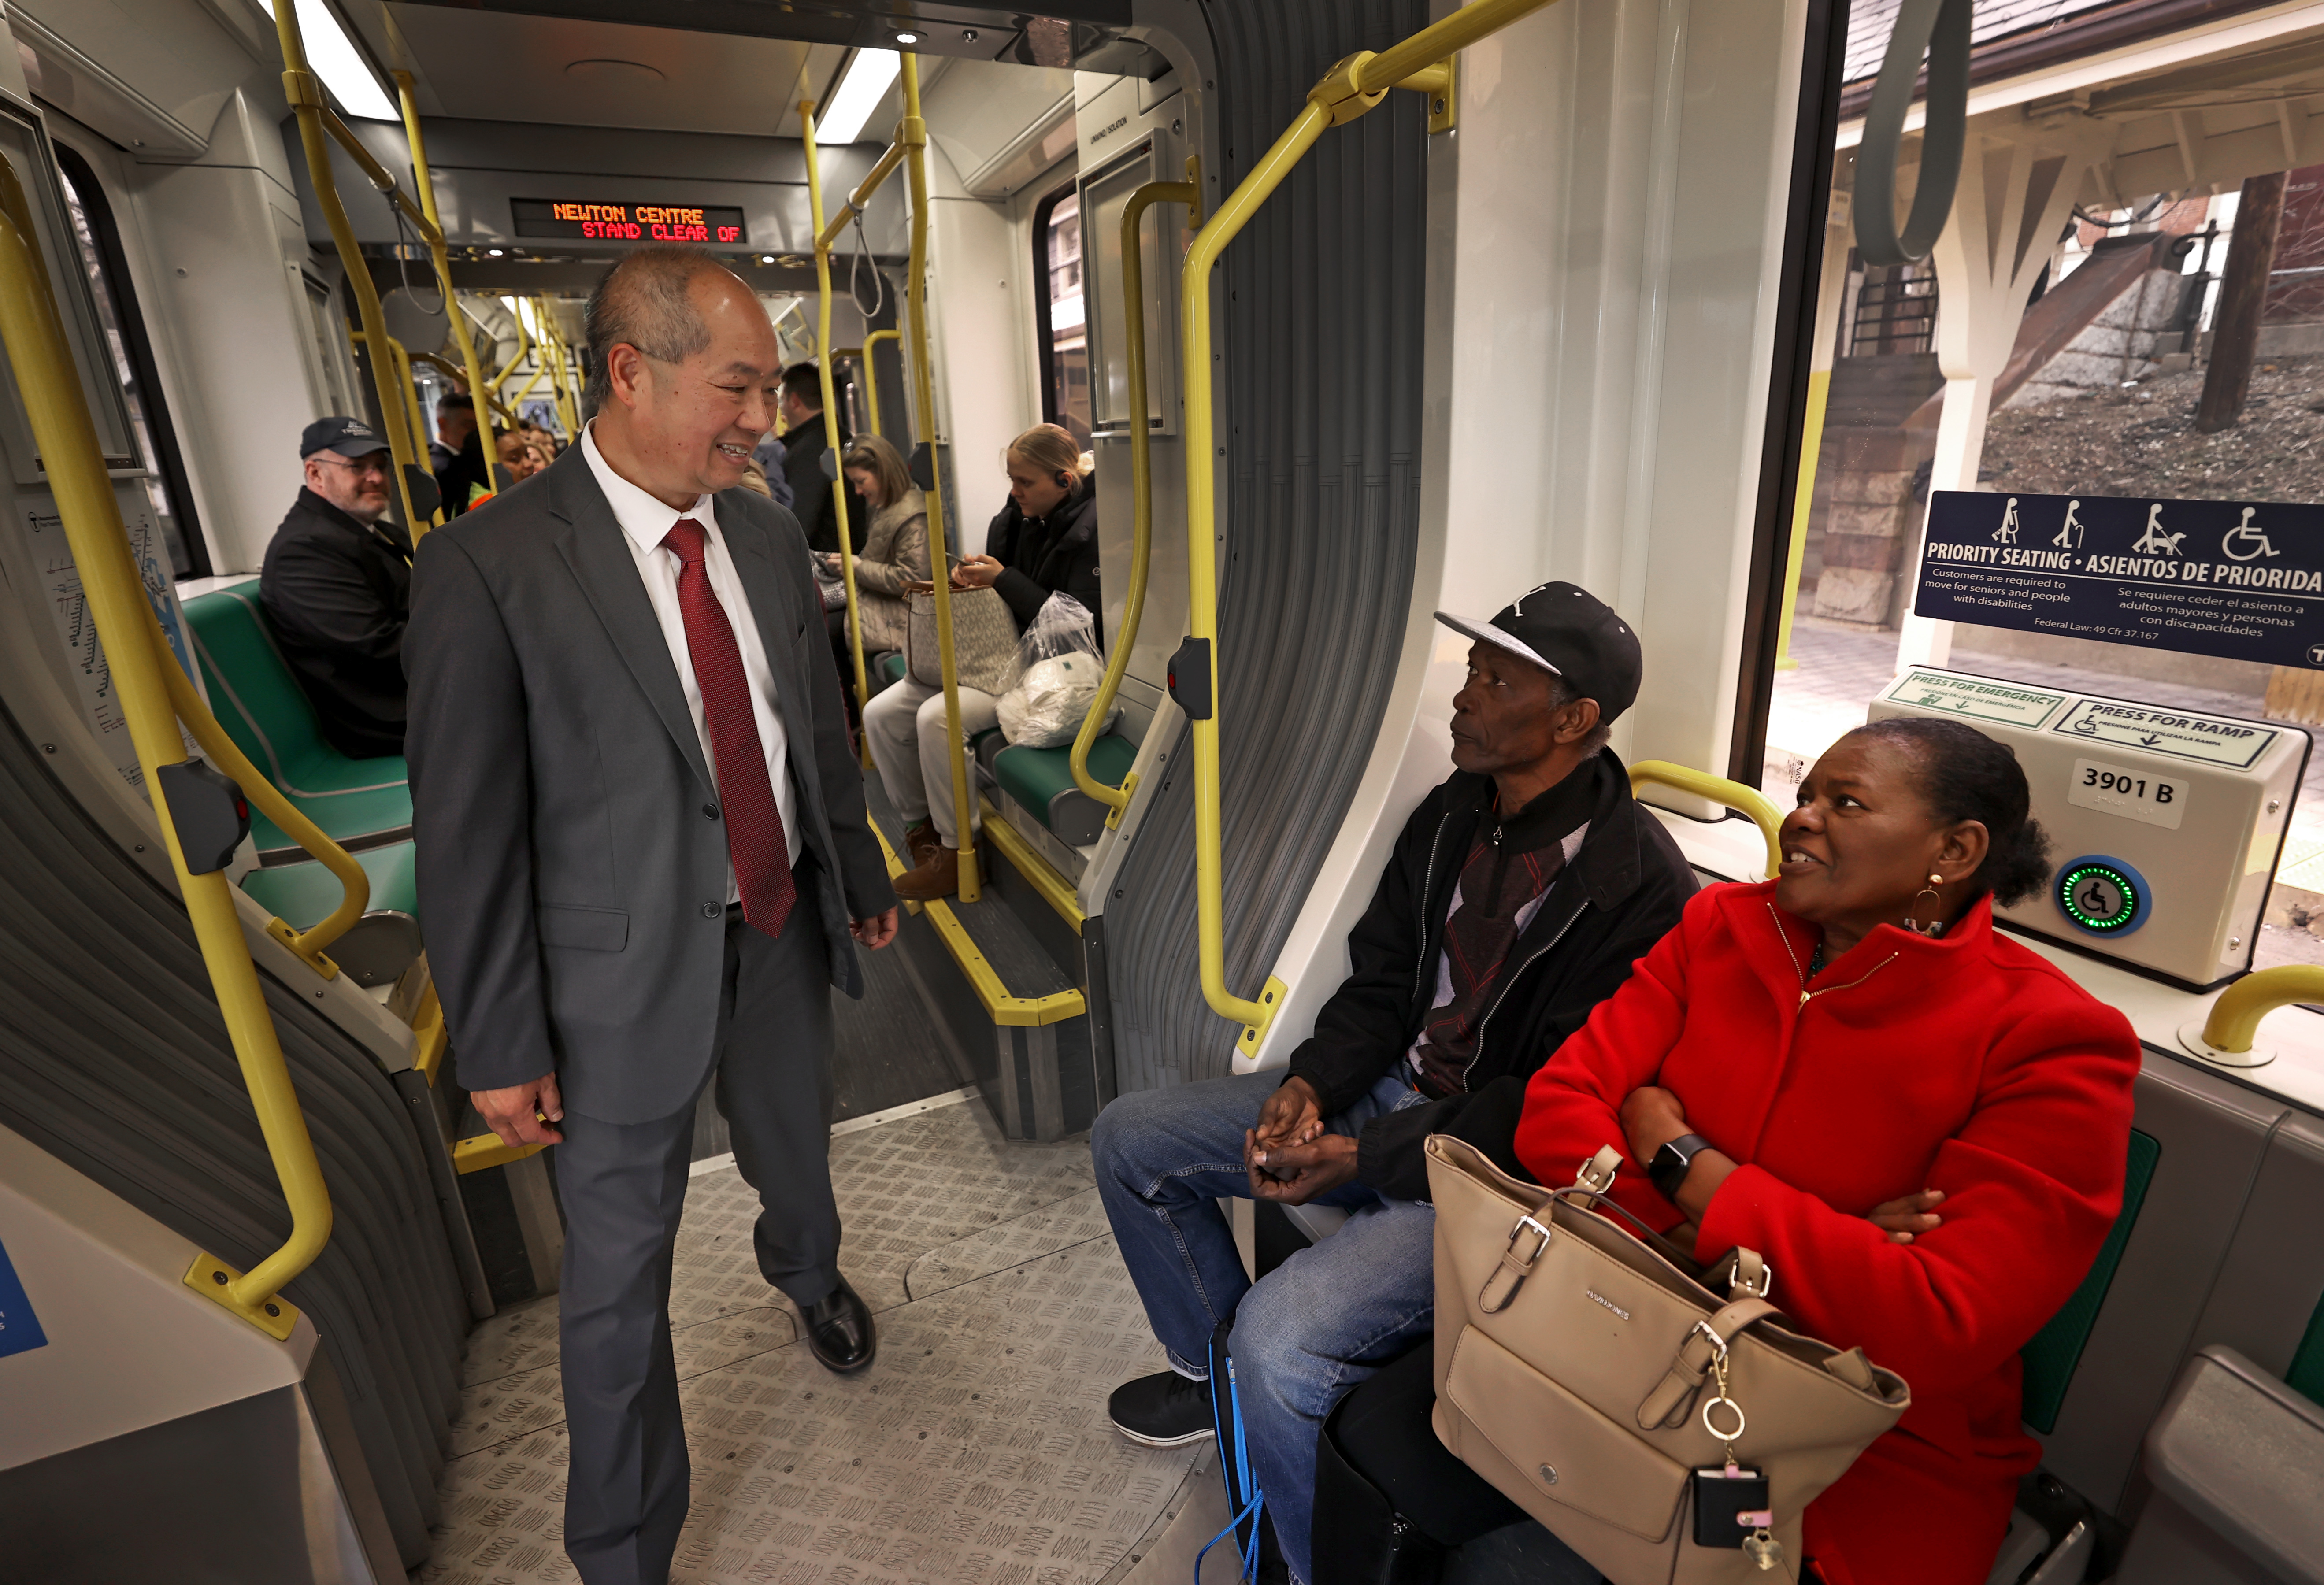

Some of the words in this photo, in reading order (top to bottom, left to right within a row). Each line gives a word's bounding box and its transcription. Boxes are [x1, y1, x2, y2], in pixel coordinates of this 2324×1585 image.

[553, 204, 627, 222] NEWTON
[635, 207, 705, 225] CENTRE
[582, 222, 641, 239] STAND
[651, 224, 709, 241] CLEAR
[717, 226, 740, 242] OF
[1927, 542, 2000, 563] PRIORITY
[2001, 548, 2071, 570] SEATING
[2085, 554, 2179, 579] ASIENTOS
[2181, 562, 2211, 582] DE
[2213, 564, 2324, 593] PRIORIDA
[1932, 568, 1985, 581] Customers
[1987, 574, 2003, 583] are
[2005, 576, 2052, 588] required
[2054, 581, 2066, 589] to
[1925, 580, 1952, 590] move
[1954, 582, 1968, 591] for
[1970, 584, 2006, 595] seniors
[2008, 589, 2029, 598] and
[2031, 592, 2071, 603] people
[1953, 594, 1975, 604] with
[1977, 597, 2033, 611] disabilities
[2117, 587, 2132, 596] Se
[2135, 589, 2186, 603] requiere
[2188, 596, 2224, 607] ceder
[2227, 598, 2239, 607] el
[2241, 601, 2292, 613] asiento
[2119, 600, 2164, 612] adultos
[2166, 607, 2220, 620] mayores
[2222, 612, 2231, 622] y
[2232, 614, 2295, 627] personas
[2035, 618, 2068, 629] Federal
[2070, 622, 2092, 632] Law:
[2107, 627, 2122, 636] Cfr
[2124, 630, 2159, 640] 37.167
[2140, 616, 2162, 625] con
[2165, 618, 2264, 637] discapacidades
[1912, 675, 1947, 687] PRESS
[1949, 681, 1977, 691] FOR
[1977, 686, 2058, 705] EMERGENCY
[1920, 688, 1949, 697] PRESIONE
[1985, 700, 2026, 711] EMERGENCIA
[2089, 705, 2148, 721] PRESS
[2148, 715, 2190, 728] FOR
[2191, 722, 2256, 739] RAMP
[2098, 721, 2131, 730] PRESIONE
[2151, 730, 2184, 740] UTILIZAR
[2194, 737, 2221, 747] RAMPA
[2083, 768, 2146, 798] 3901
[2156, 783, 2174, 803] B
